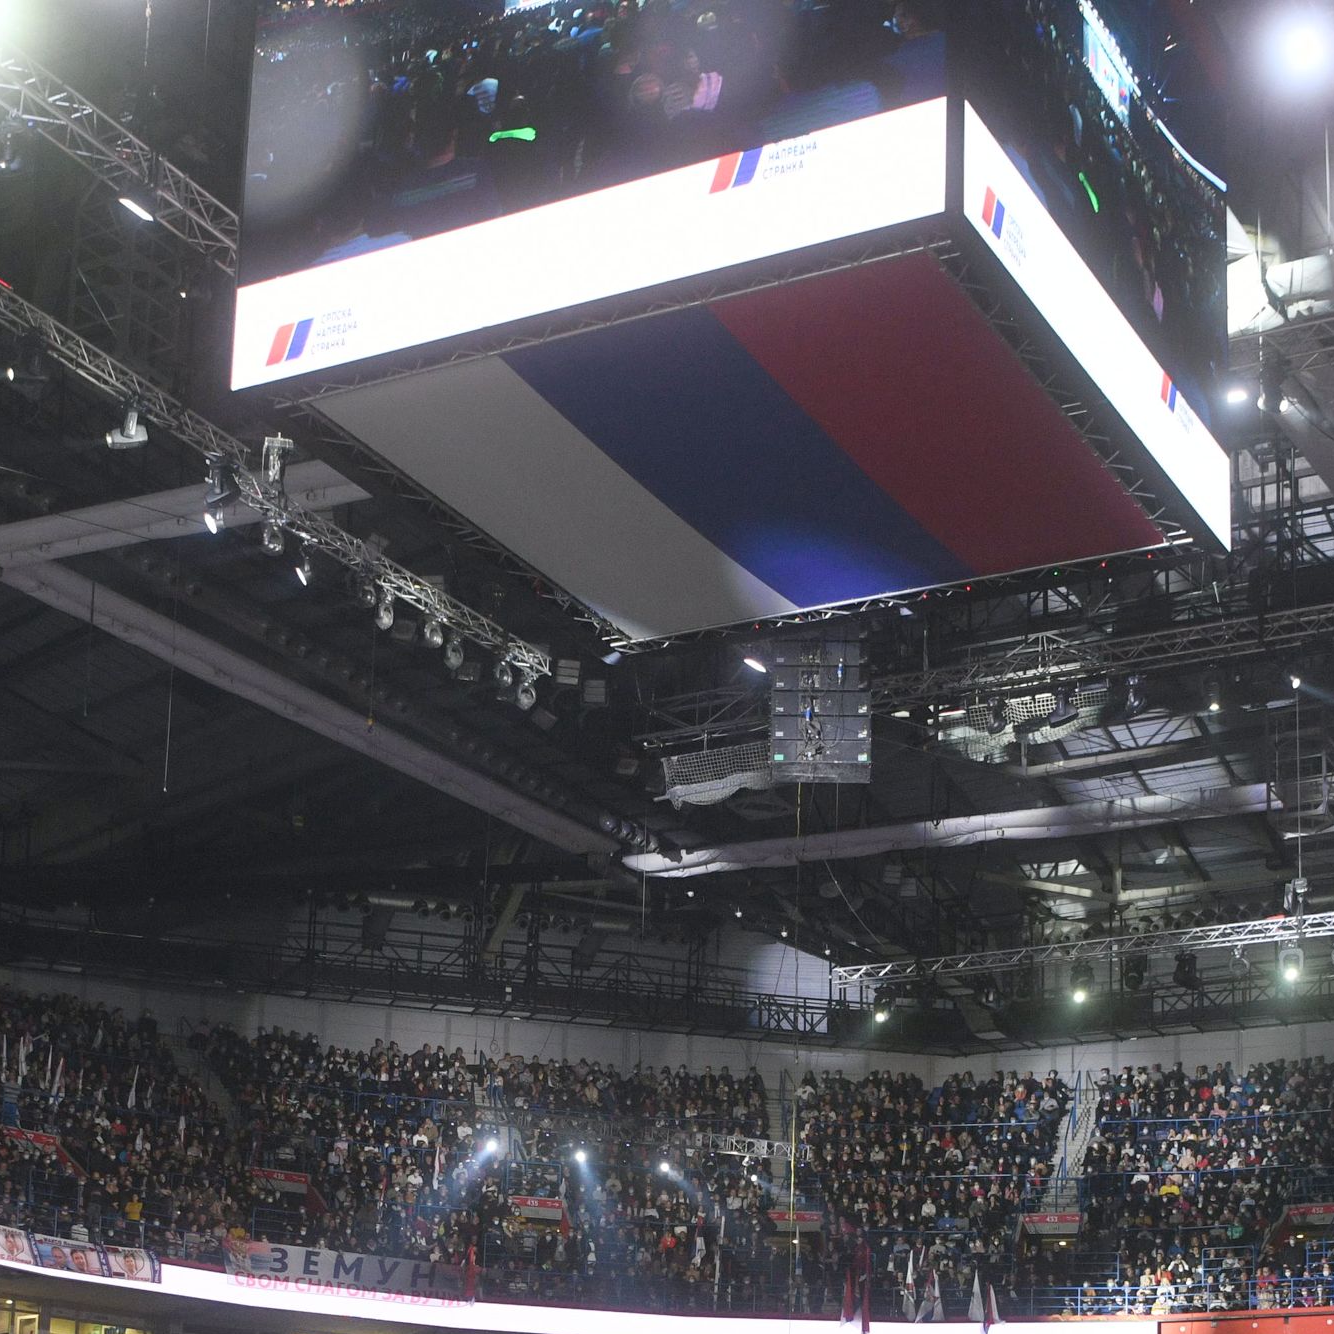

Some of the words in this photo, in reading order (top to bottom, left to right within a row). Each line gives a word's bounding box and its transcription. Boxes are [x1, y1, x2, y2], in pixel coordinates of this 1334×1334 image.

[269, 1247, 437, 1287] ЗЕМУН
[235, 1271, 289, 1289] СВОМ
[295, 1277, 377, 1298] СНАГОМ
[381, 1289, 406, 1301] ЗА
